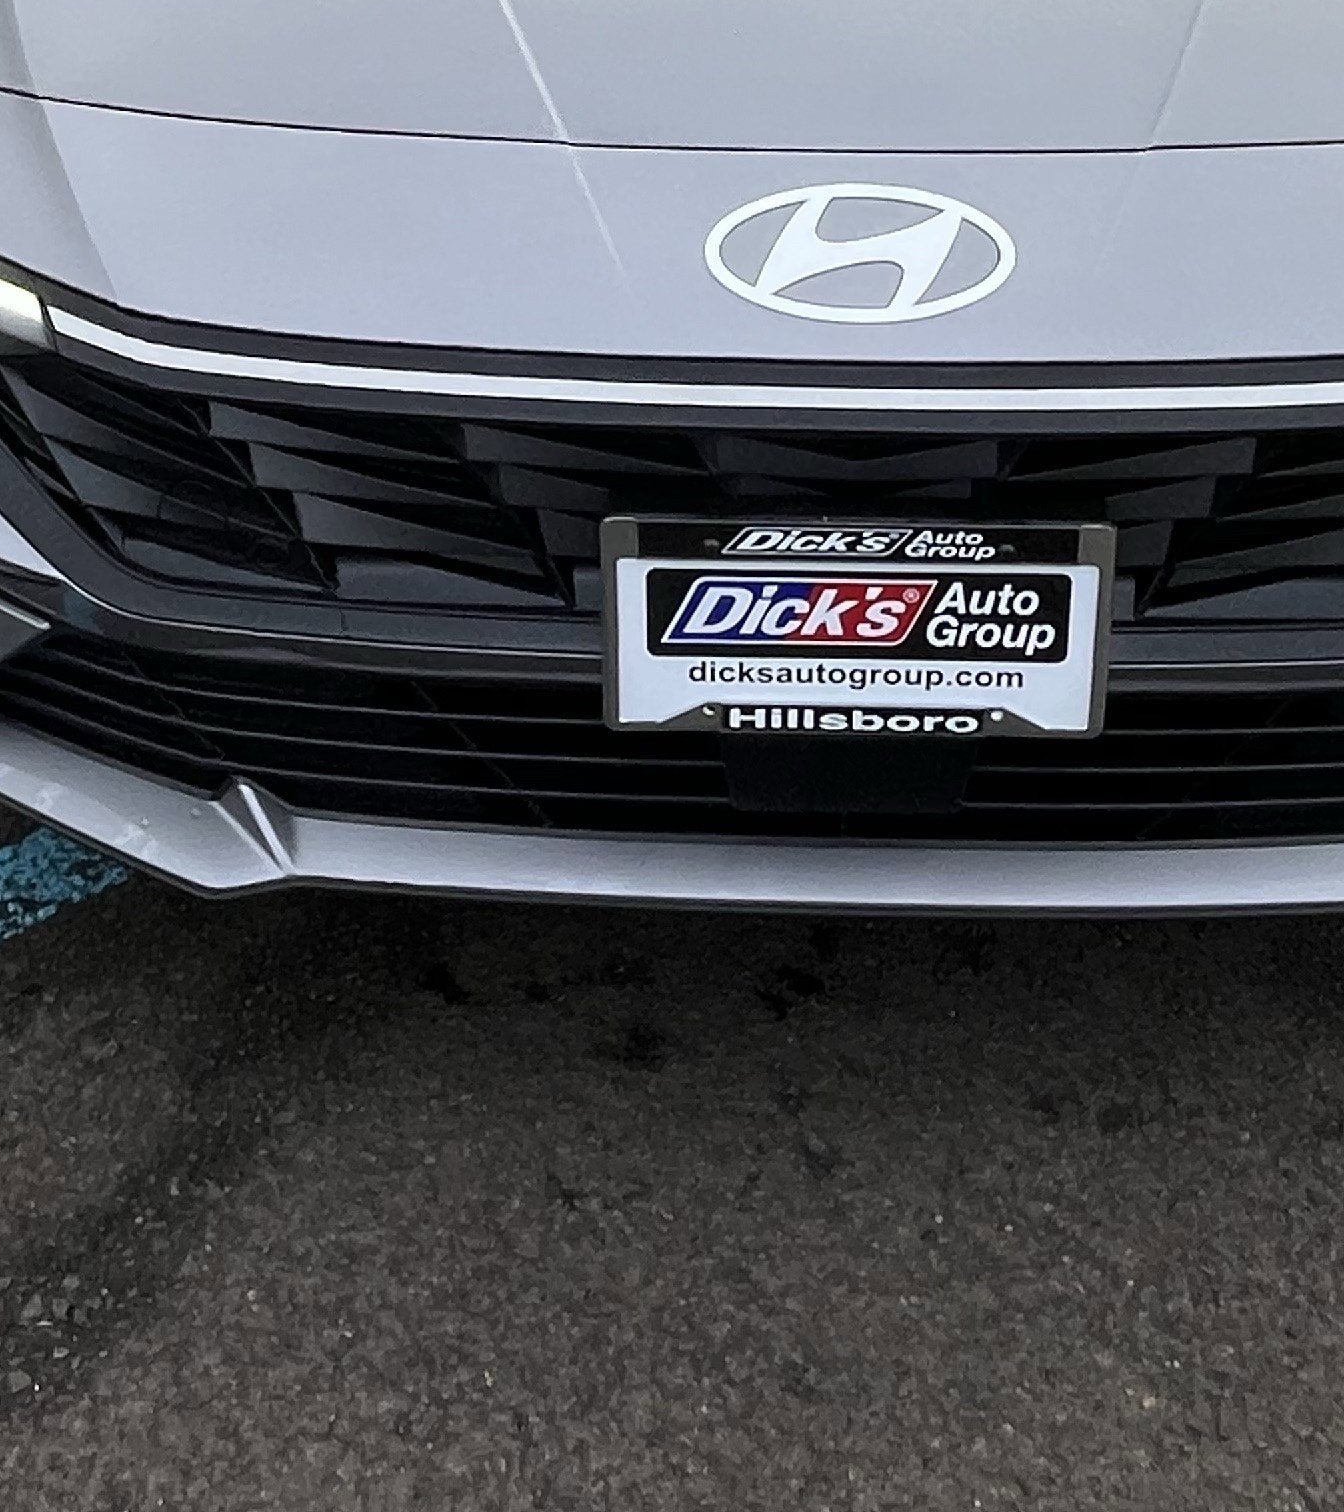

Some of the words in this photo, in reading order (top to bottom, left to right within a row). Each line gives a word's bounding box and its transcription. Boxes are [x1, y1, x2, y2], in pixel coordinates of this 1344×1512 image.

[908, 530, 984, 545] Auto
[905, 543, 996, 560] Group
[935, 582, 1040, 617] Auto
[926, 615, 1055, 656] Group
[688, 661, 1024, 690] dicksautogroup.com
[729, 708, 979, 734] Hillsboro
